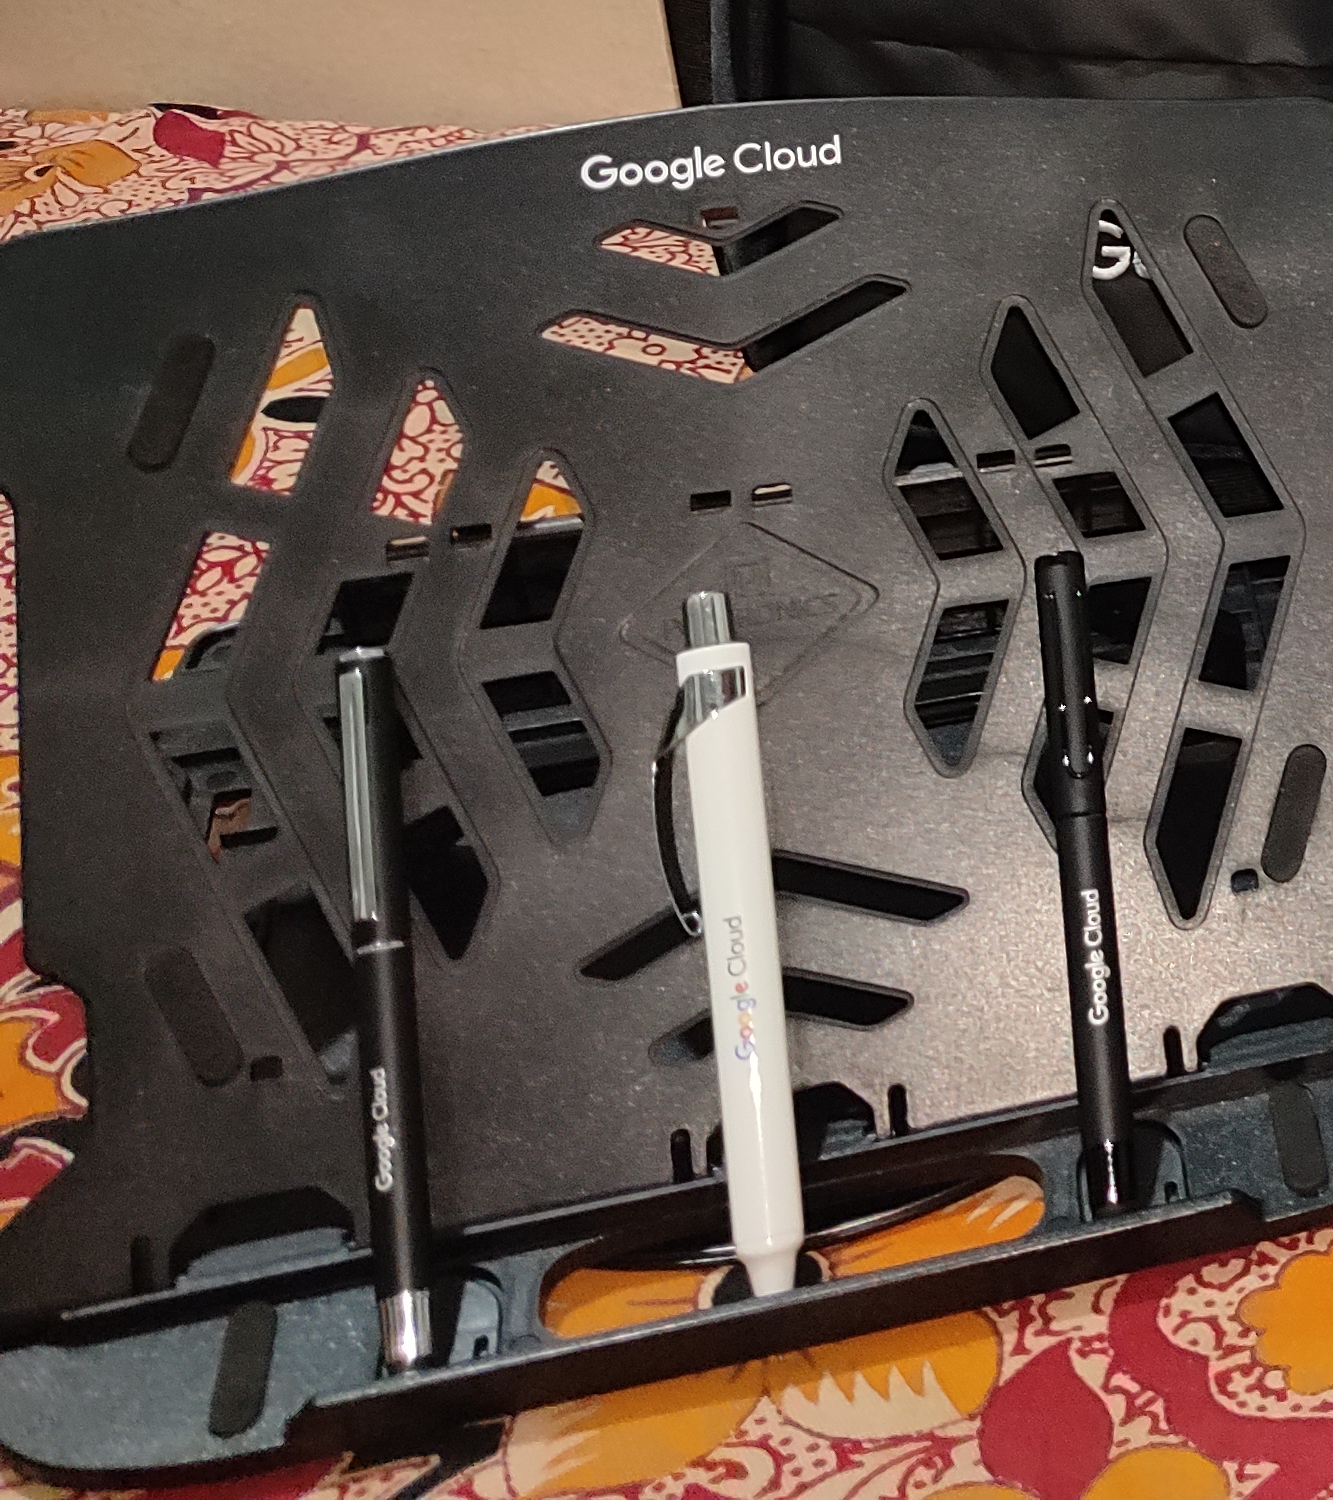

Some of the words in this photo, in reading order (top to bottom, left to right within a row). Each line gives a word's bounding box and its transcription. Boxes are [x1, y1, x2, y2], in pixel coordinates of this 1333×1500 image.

[581, 145, 726, 190] Google
[733, 134, 842, 173] Cloud
[723, 915, 747, 977] Cloud
[1080, 888, 1103, 948] Cloud
[1083, 949, 1111, 1026] Google
[730, 980, 757, 1061] Google
[370, 1067, 389, 1121] Cloud
[372, 1122, 396, 1192] Google
